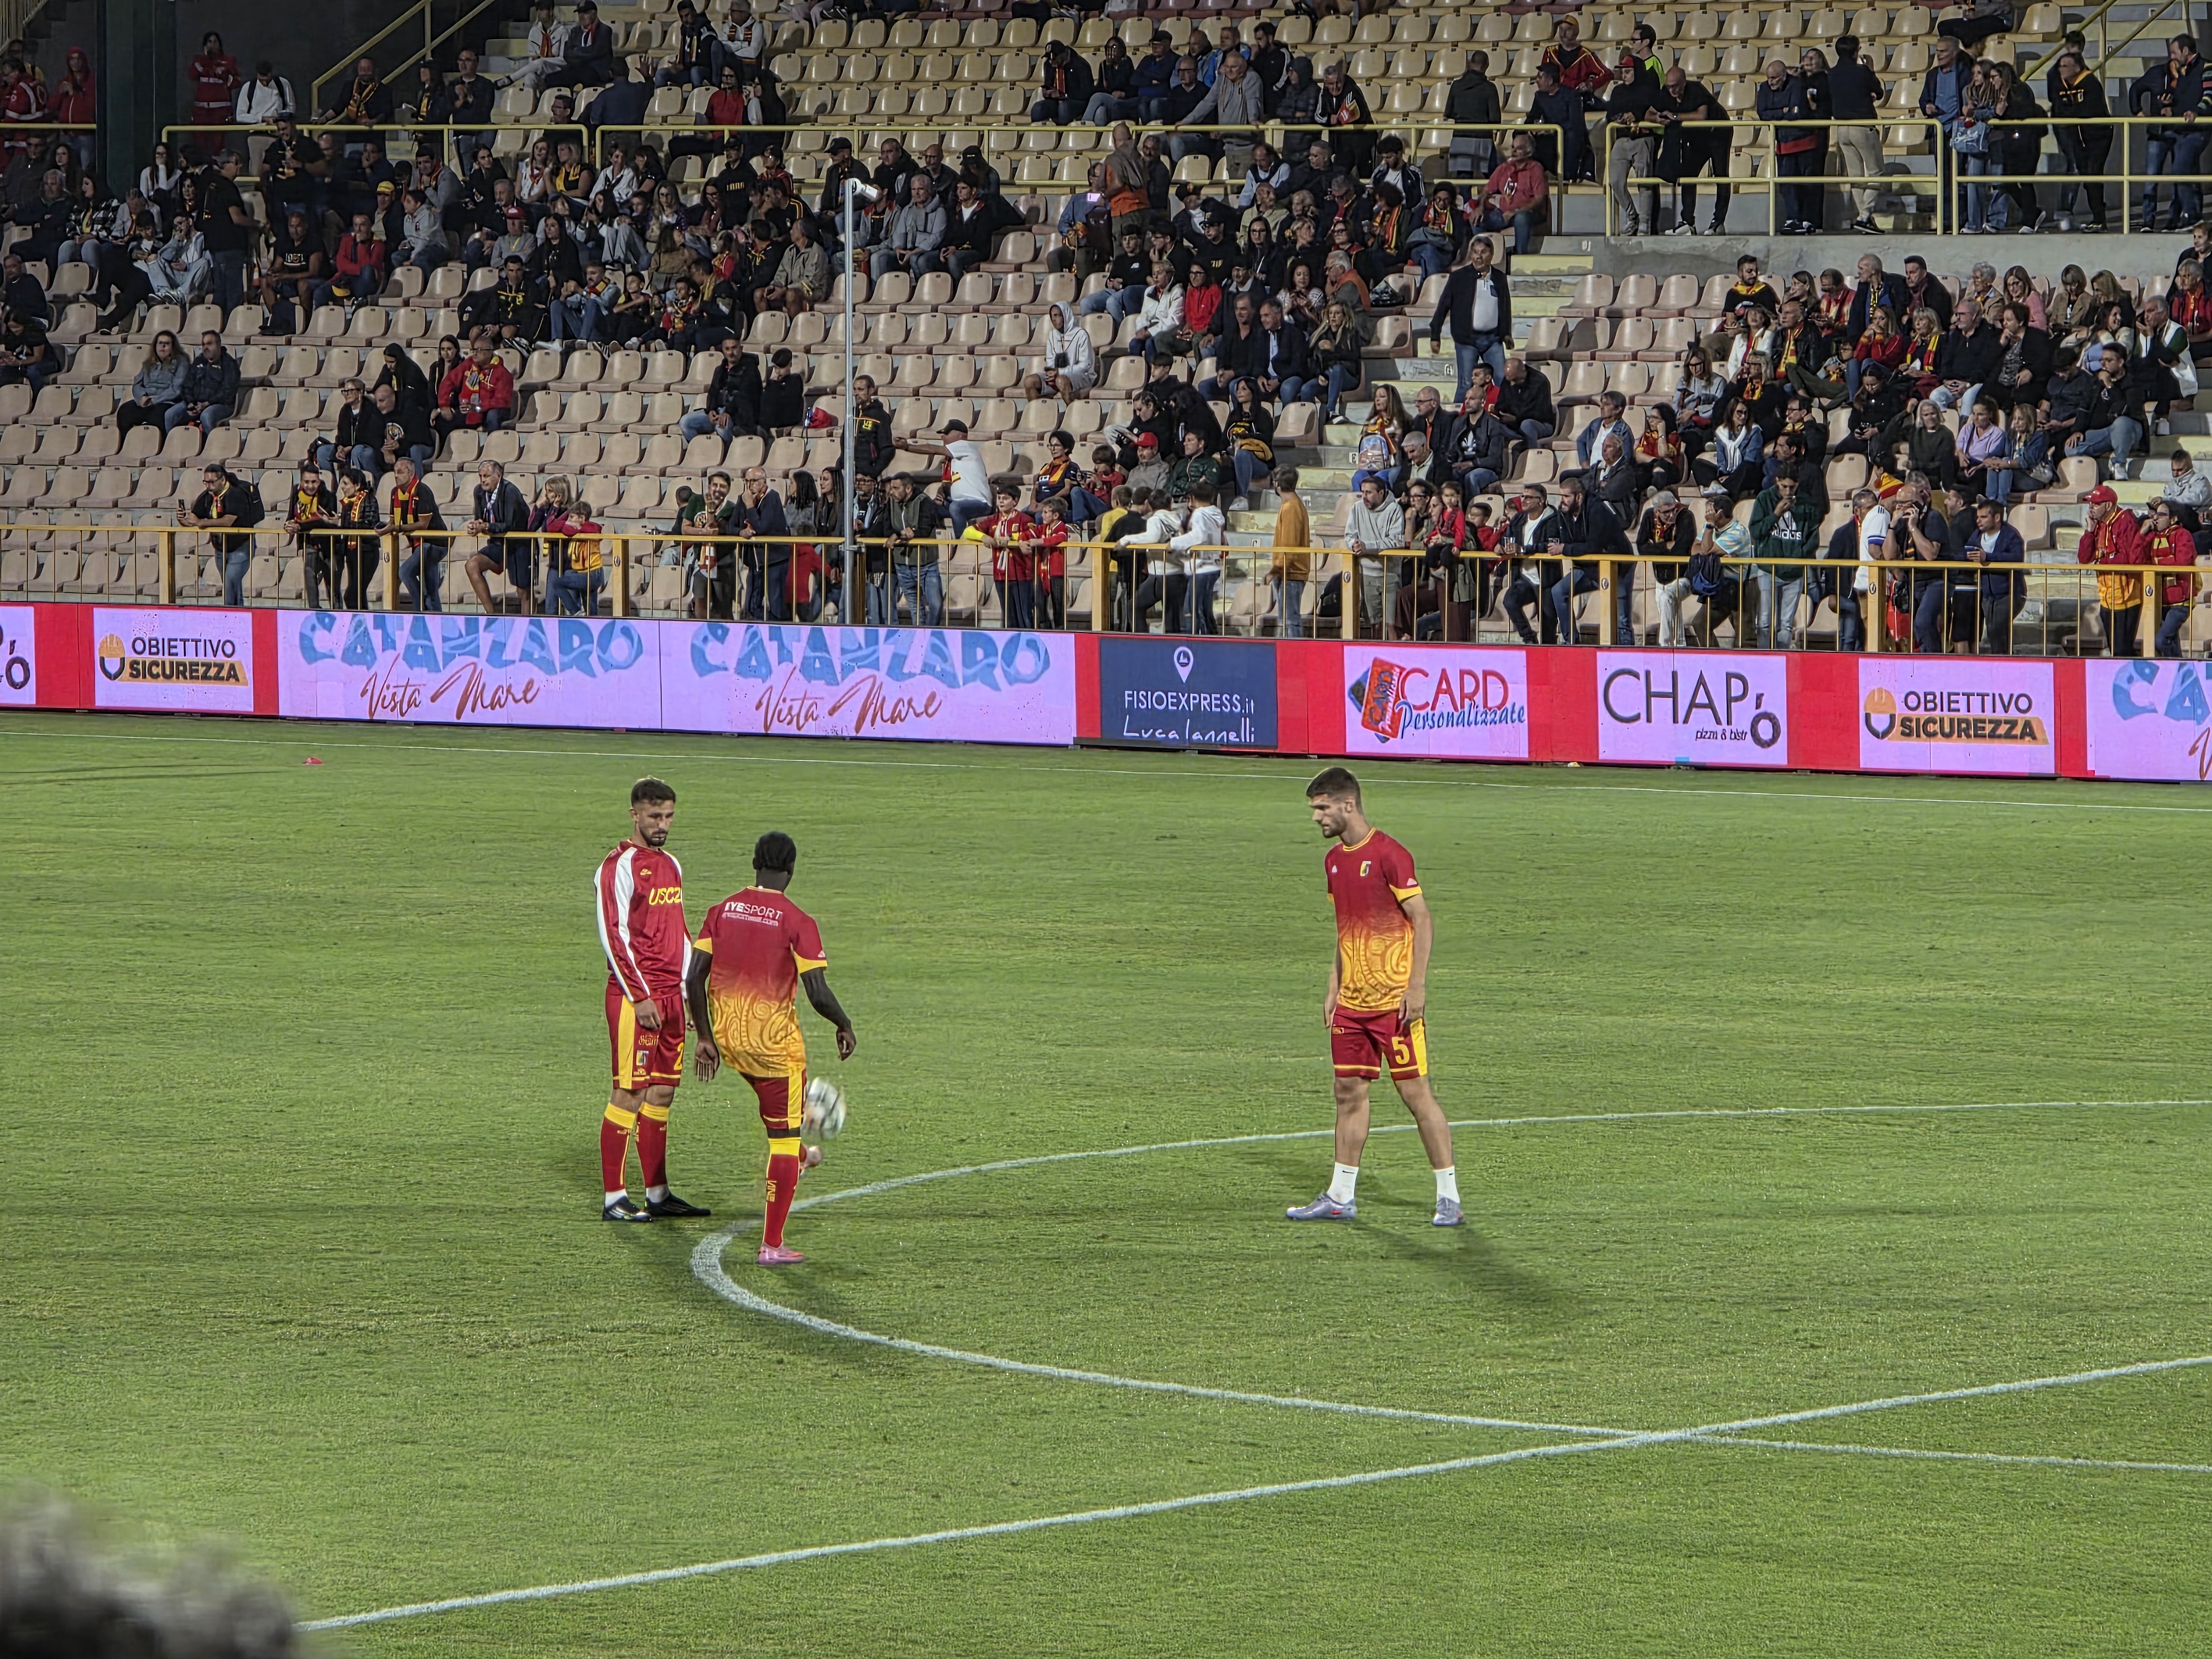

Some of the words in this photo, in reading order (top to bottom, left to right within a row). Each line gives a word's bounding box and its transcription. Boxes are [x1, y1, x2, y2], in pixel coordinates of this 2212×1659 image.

[132, 637, 236, 659] OBIETTIVO
[299, 612, 643, 677] CATANZARO
[691, 622, 1050, 691] CATANZARO
[128, 660, 241, 682] SICUREZZA
[361, 653, 426, 719] Vista
[430, 661, 540, 720] Mare
[755, 666, 825, 733] Vista
[828, 674, 942, 735] Mare
[1400, 667, 1510, 713] CARD
[1903, 690, 2033, 714] OBIETTIVO
[2112, 660, 2212, 726] CA
[1123, 714, 1179, 739] Luca
[1395, 700, 1526, 739] Personalizzate
[1899, 716, 2037, 740] SICUREZZA
[649, 886, 681, 905] USCZ
[1391, 1036, 1410, 1065] 5
